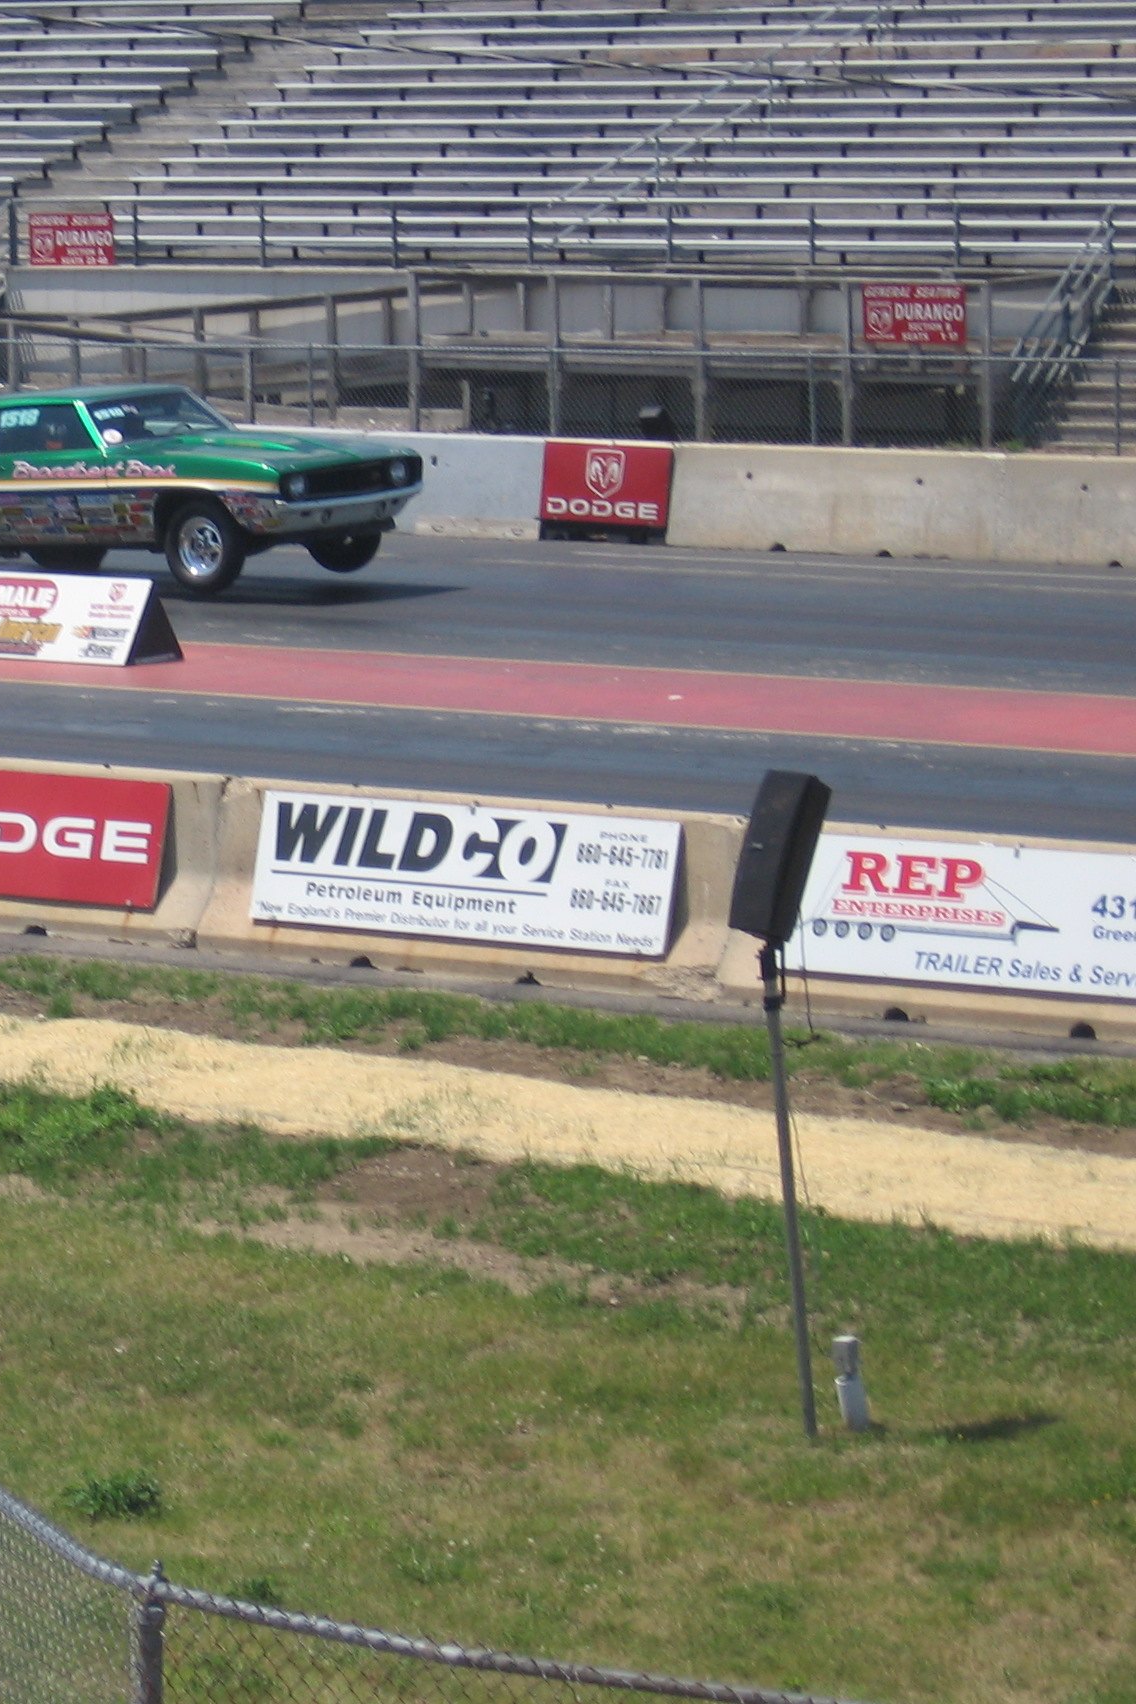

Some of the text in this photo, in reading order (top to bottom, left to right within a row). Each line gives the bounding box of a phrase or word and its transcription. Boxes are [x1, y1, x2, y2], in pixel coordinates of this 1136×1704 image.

[55, 229, 113, 247] DURANGO
[894, 302, 964, 321] DURANGO
[546, 497, 659, 521] DODGE
[274, 801, 568, 883] WILDCO
[599, 831, 649, 842] PHONE
[605, 879, 630, 889] FAX
[842, 851, 986, 902] REP
[306, 882, 517, 914] Petroleum Equipment
[287, 901, 340, 919] England's
[344, 907, 387, 923] Premier
[390, 911, 450, 929] Distributor
[454, 917, 470, 931] for
[474, 919, 488, 932] all
[492, 923, 517, 936] your
[522, 923, 565, 940] Service
[570, 928, 613, 944] Station
[831, 899, 1006, 927] ENTERPRISES
[914, 950, 1004, 978] TRAILER
[1008, 959, 1062, 981] Sales
[1069, 964, 1082, 983] &
